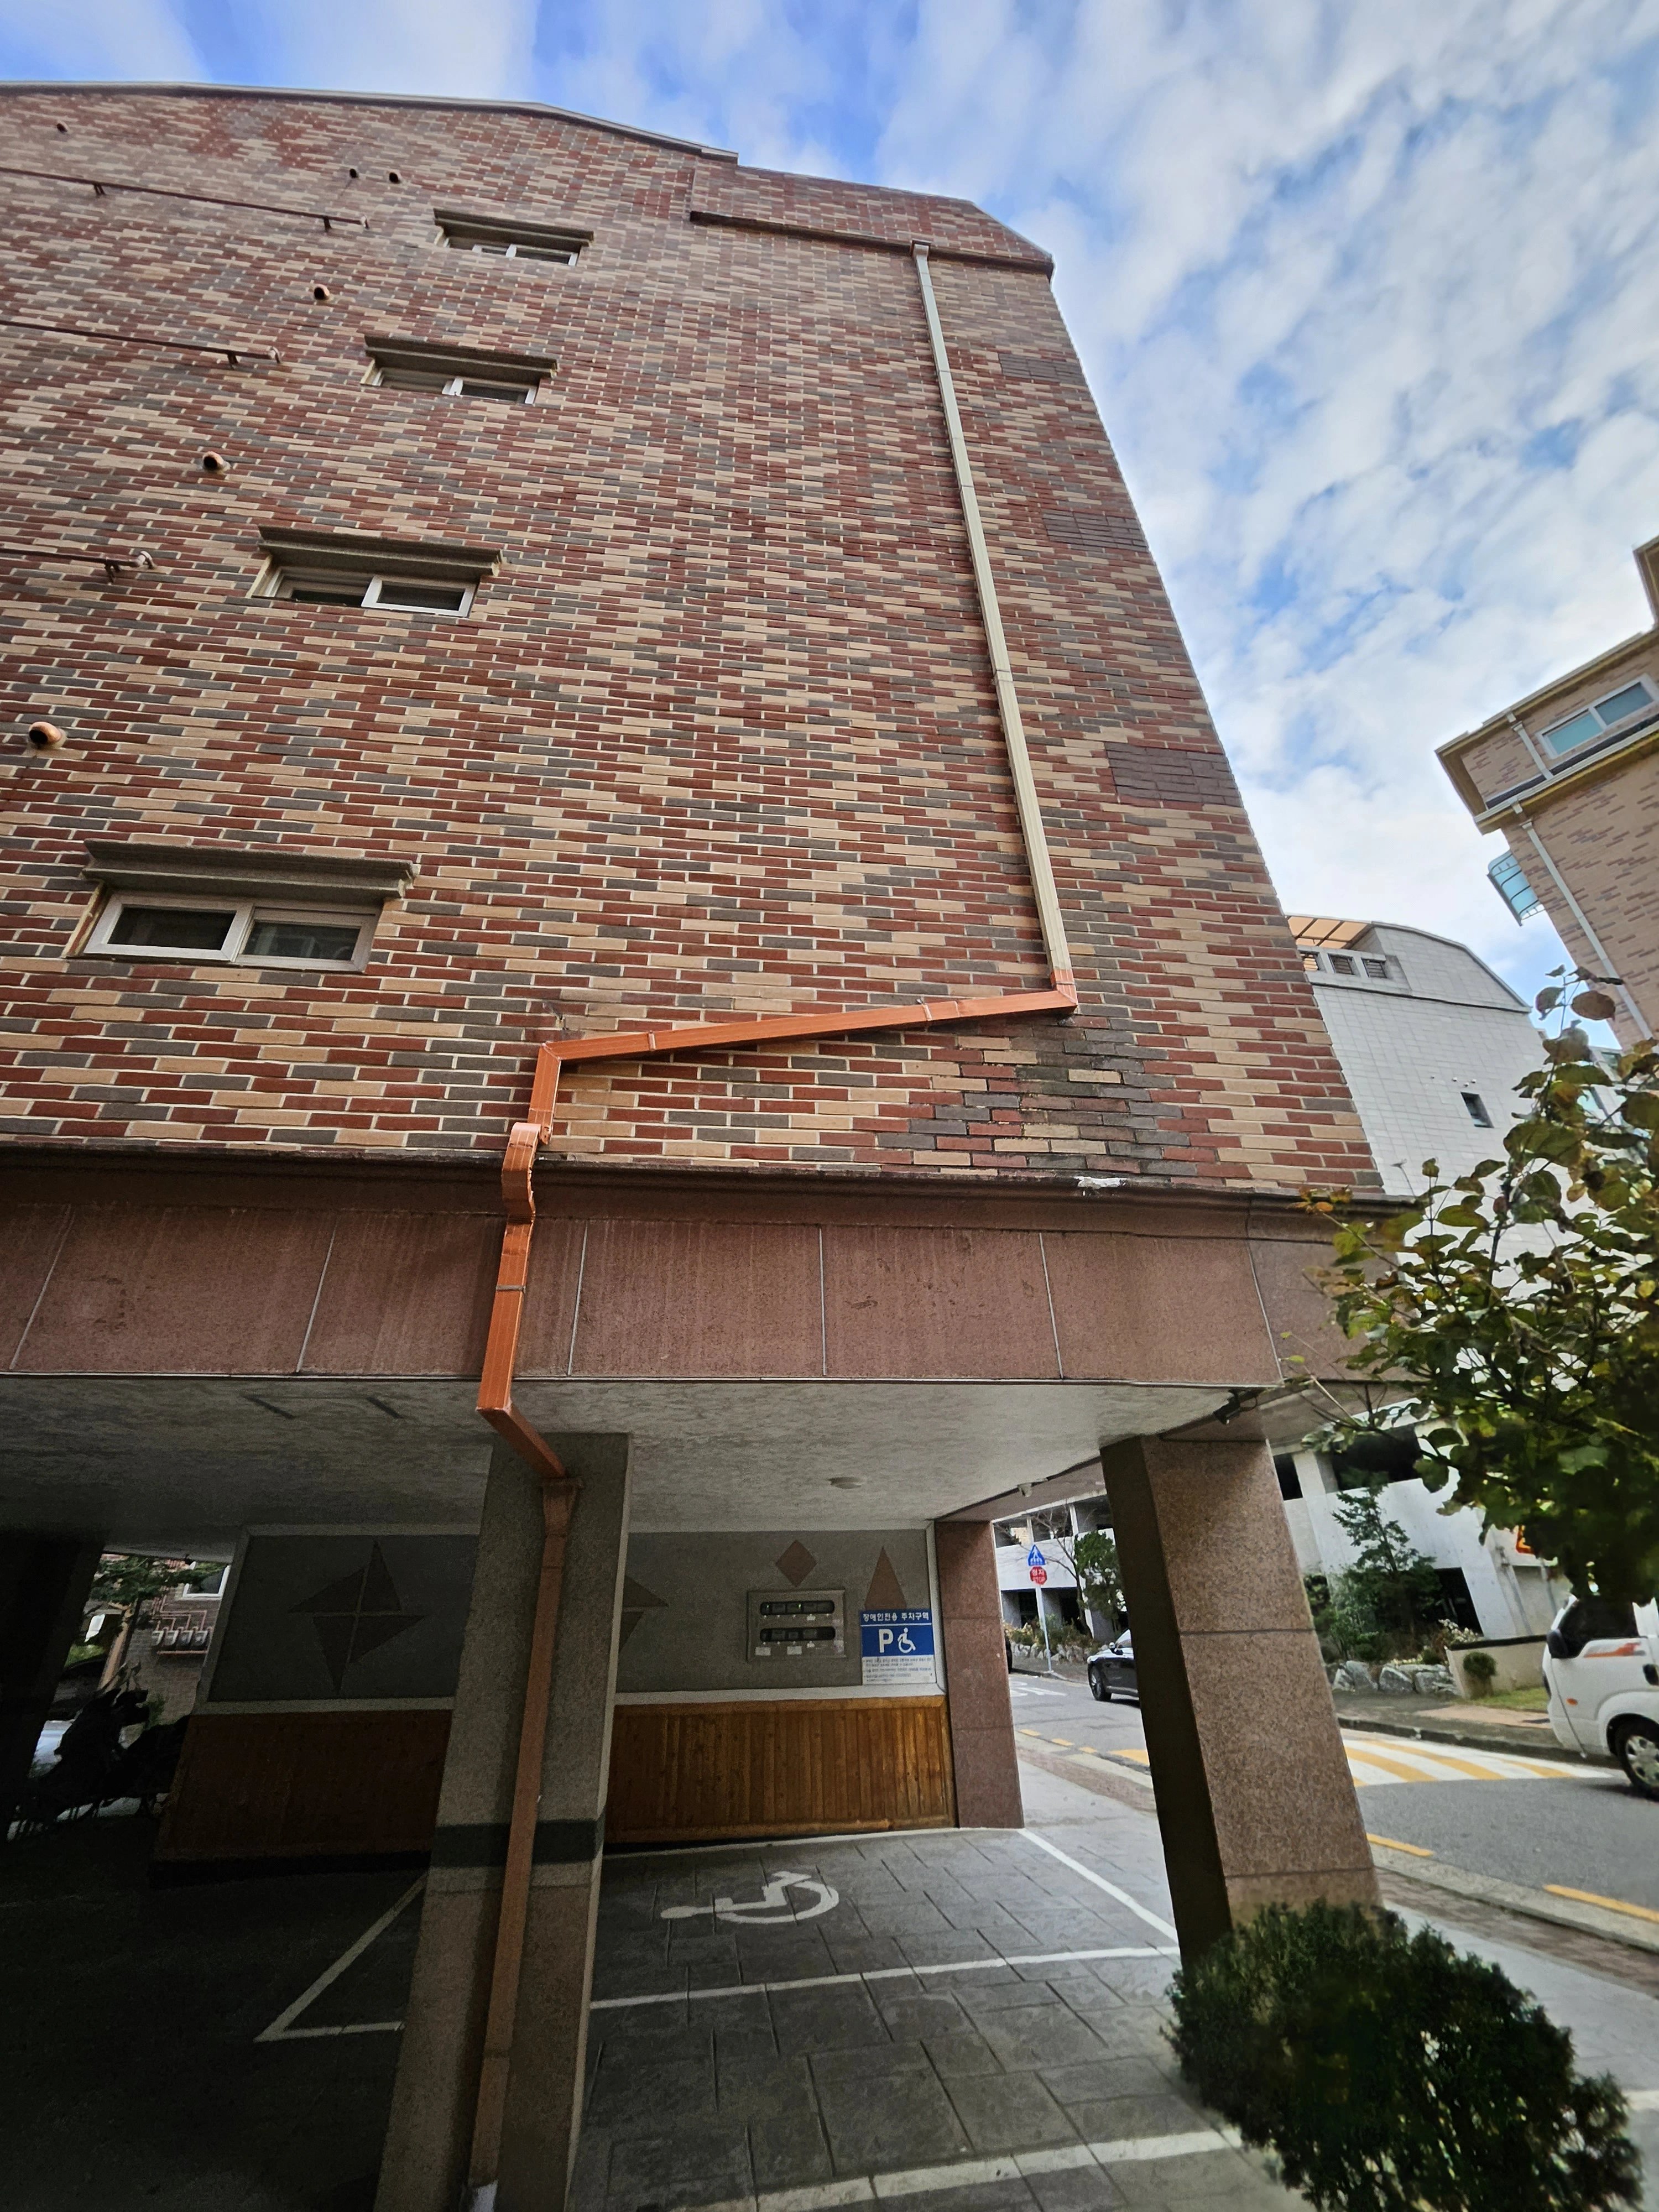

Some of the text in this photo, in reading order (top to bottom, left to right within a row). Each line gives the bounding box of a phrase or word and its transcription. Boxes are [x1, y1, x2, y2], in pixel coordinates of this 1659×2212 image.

[863, 1612, 929, 1622] 장애인전용 주차구역
[879, 1629, 894, 1653] P
